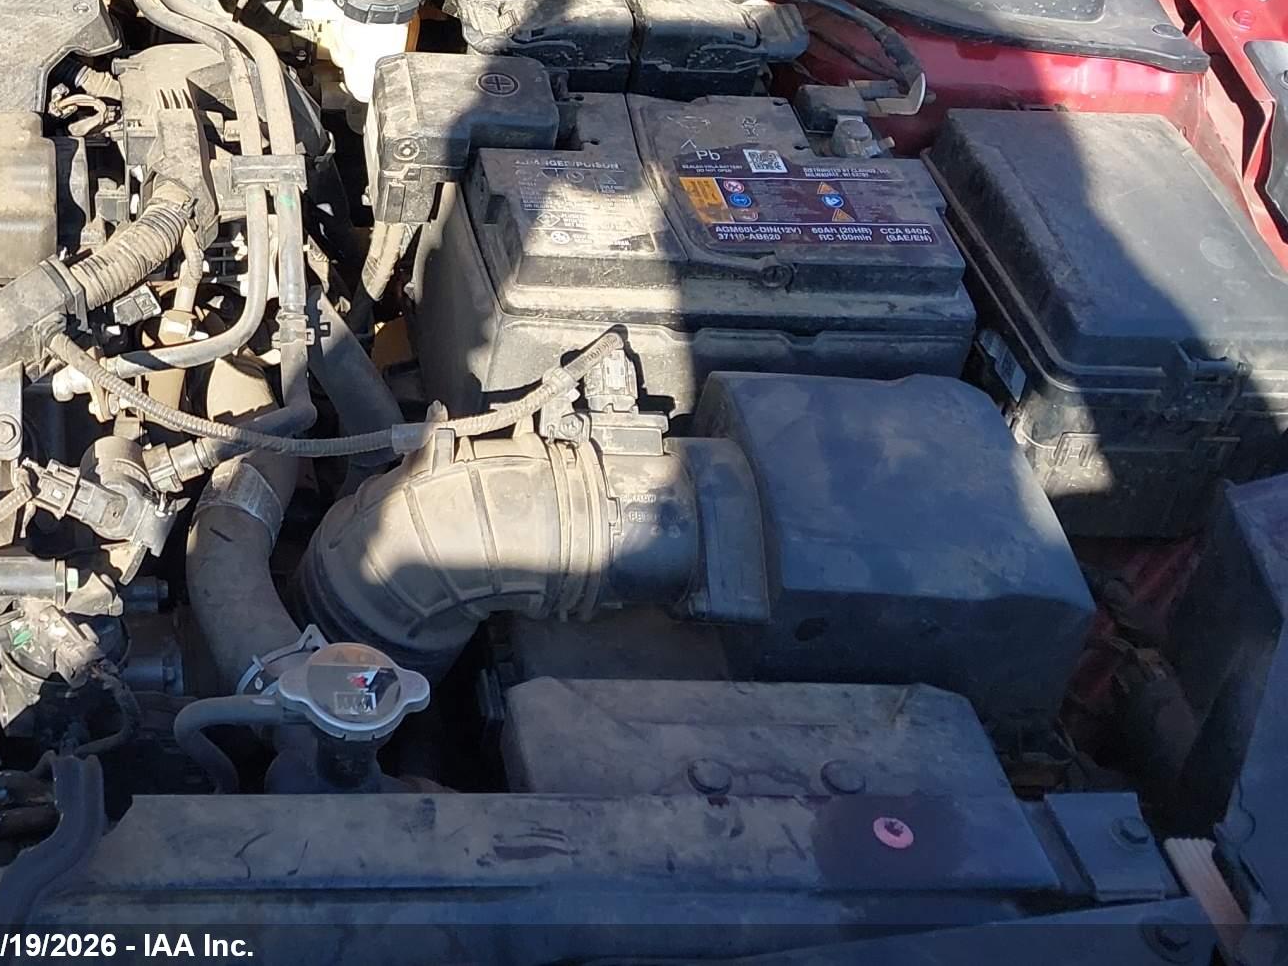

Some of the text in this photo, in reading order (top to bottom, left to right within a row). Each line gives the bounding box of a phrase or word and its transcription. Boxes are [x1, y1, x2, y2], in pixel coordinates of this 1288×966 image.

[696, 150, 721, 161] Pb
[838, 227, 873, 236] (20HR)
[886, 234, 933, 243] (SAE/EN)
